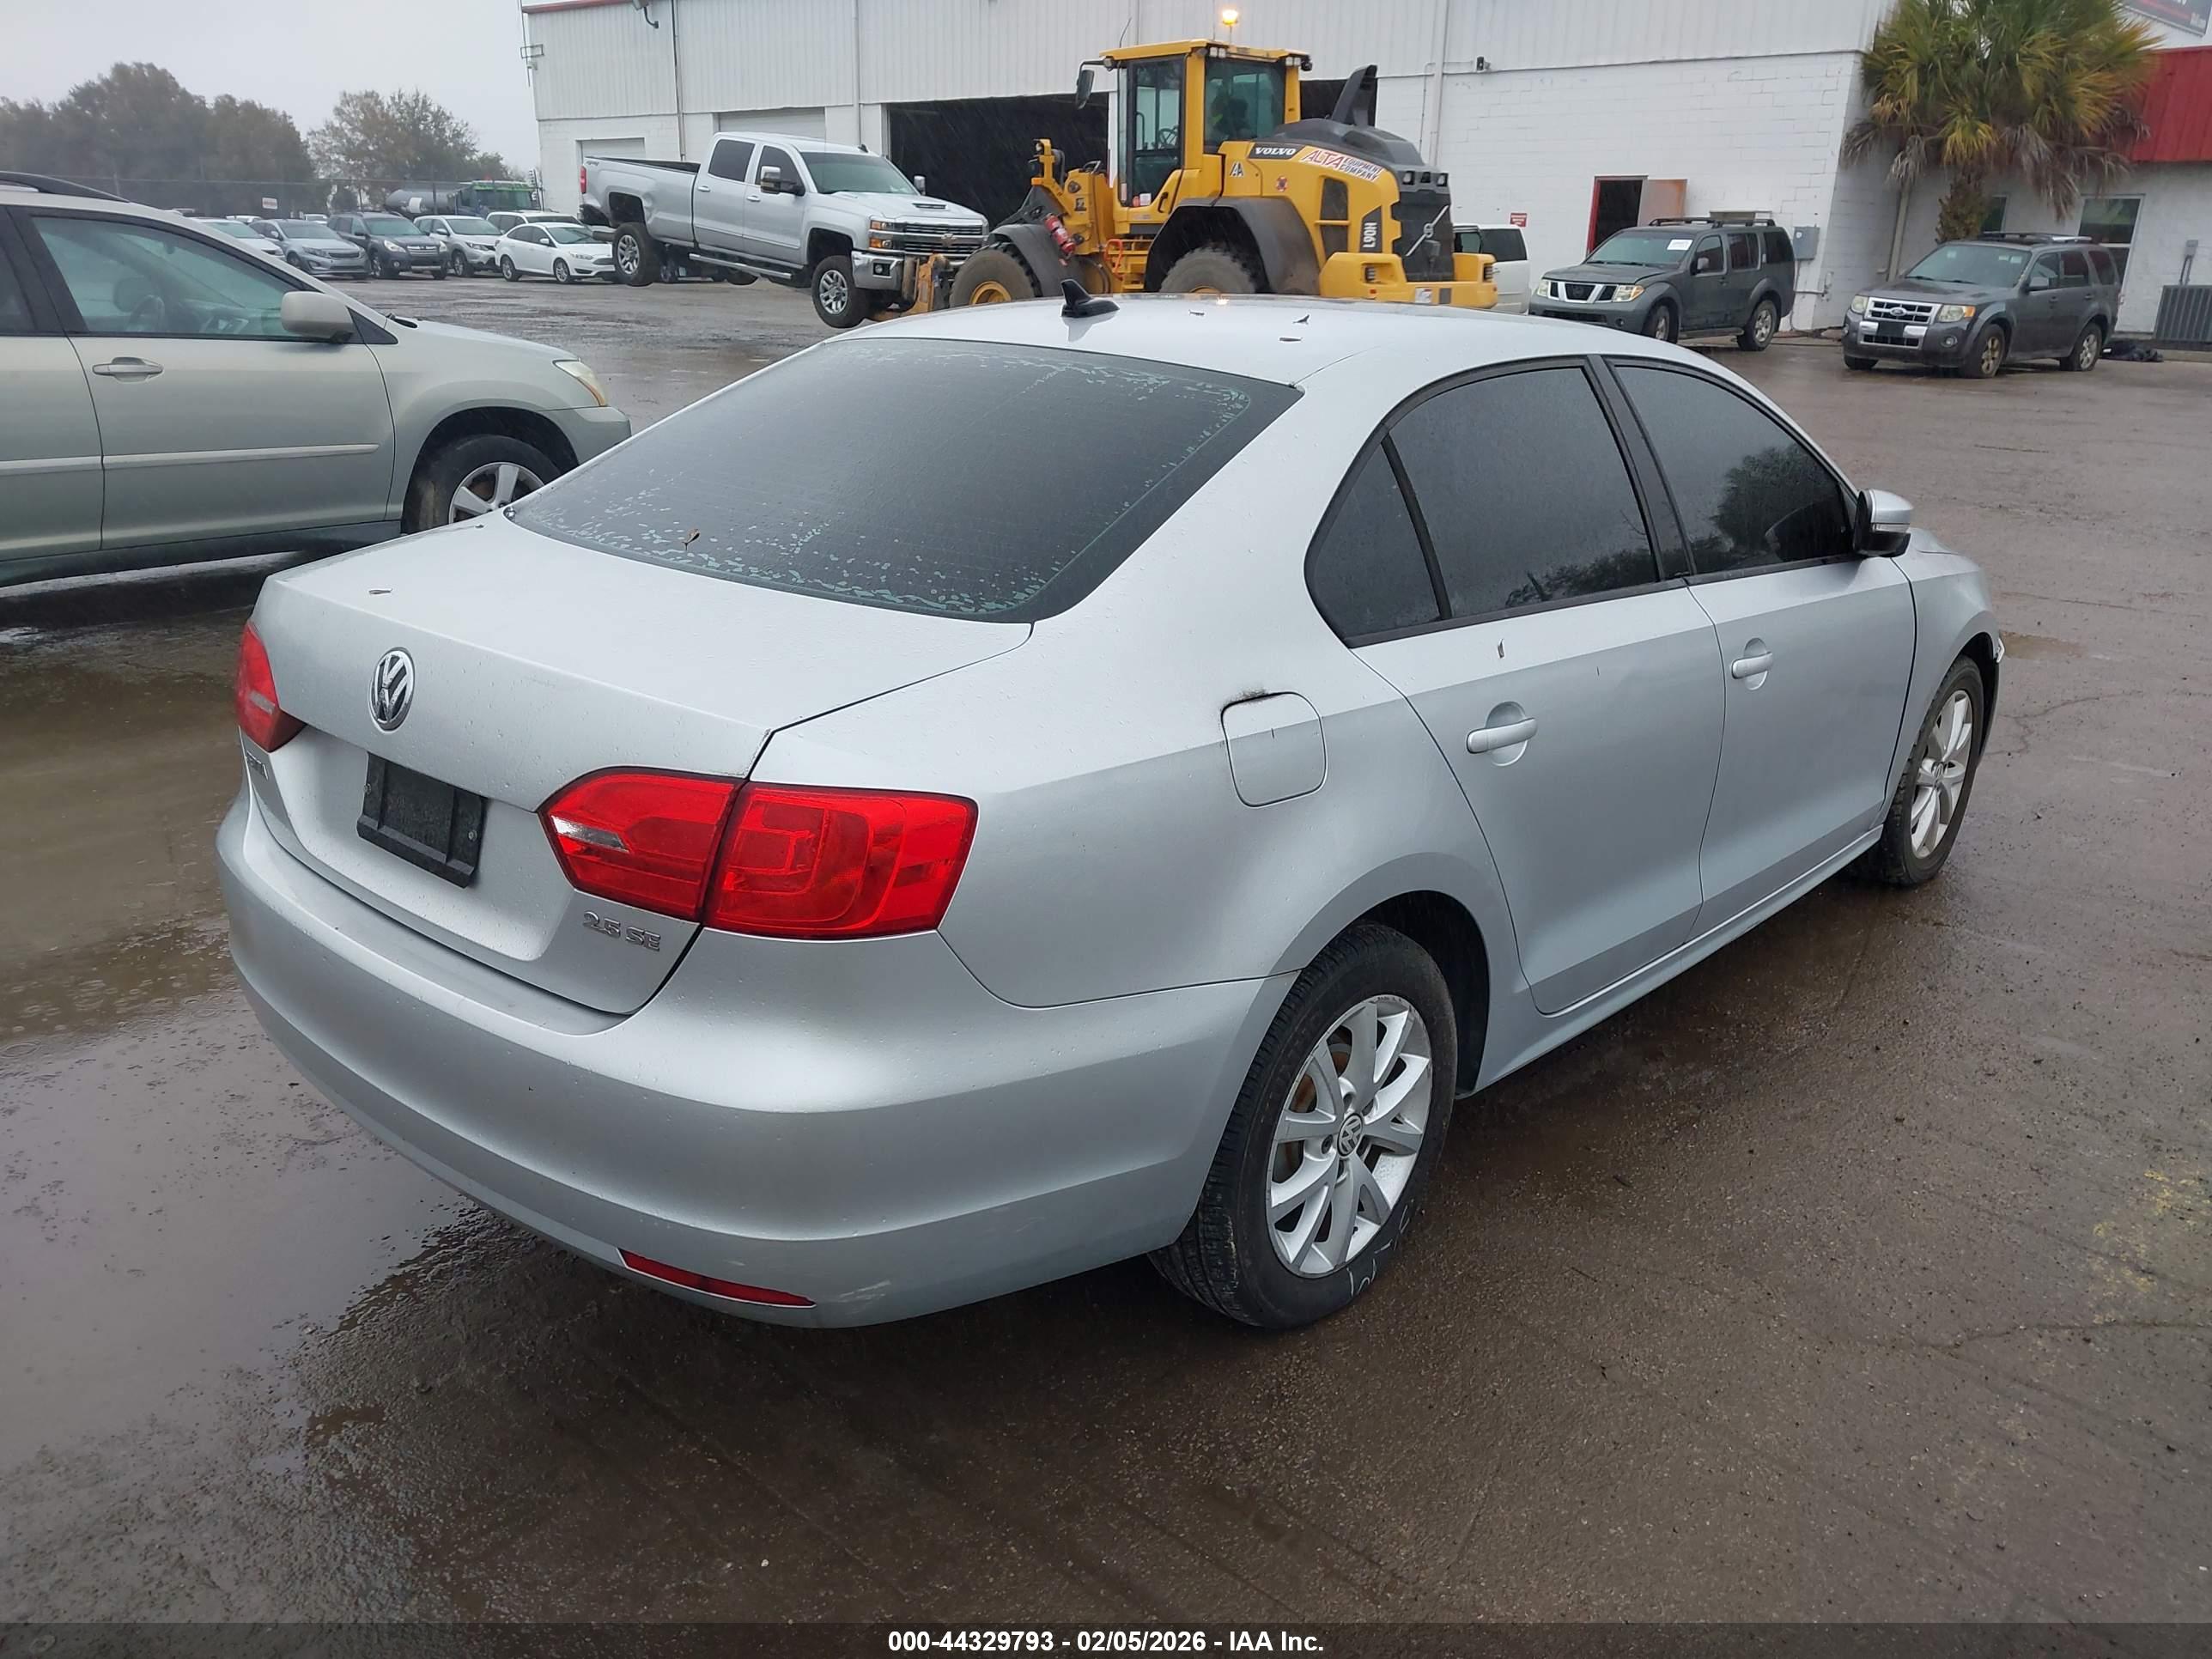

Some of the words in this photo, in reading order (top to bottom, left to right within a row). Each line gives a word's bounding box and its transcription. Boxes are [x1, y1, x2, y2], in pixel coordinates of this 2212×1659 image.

[1255, 147, 1297, 155] VOLVO
[1301, 149, 1345, 169] ALTA
[1340, 164, 1378, 181] COMPANY
[1362, 222, 1378, 248] L90H
[583, 910, 621, 938] 2.5
[626, 926, 661, 952] SE
